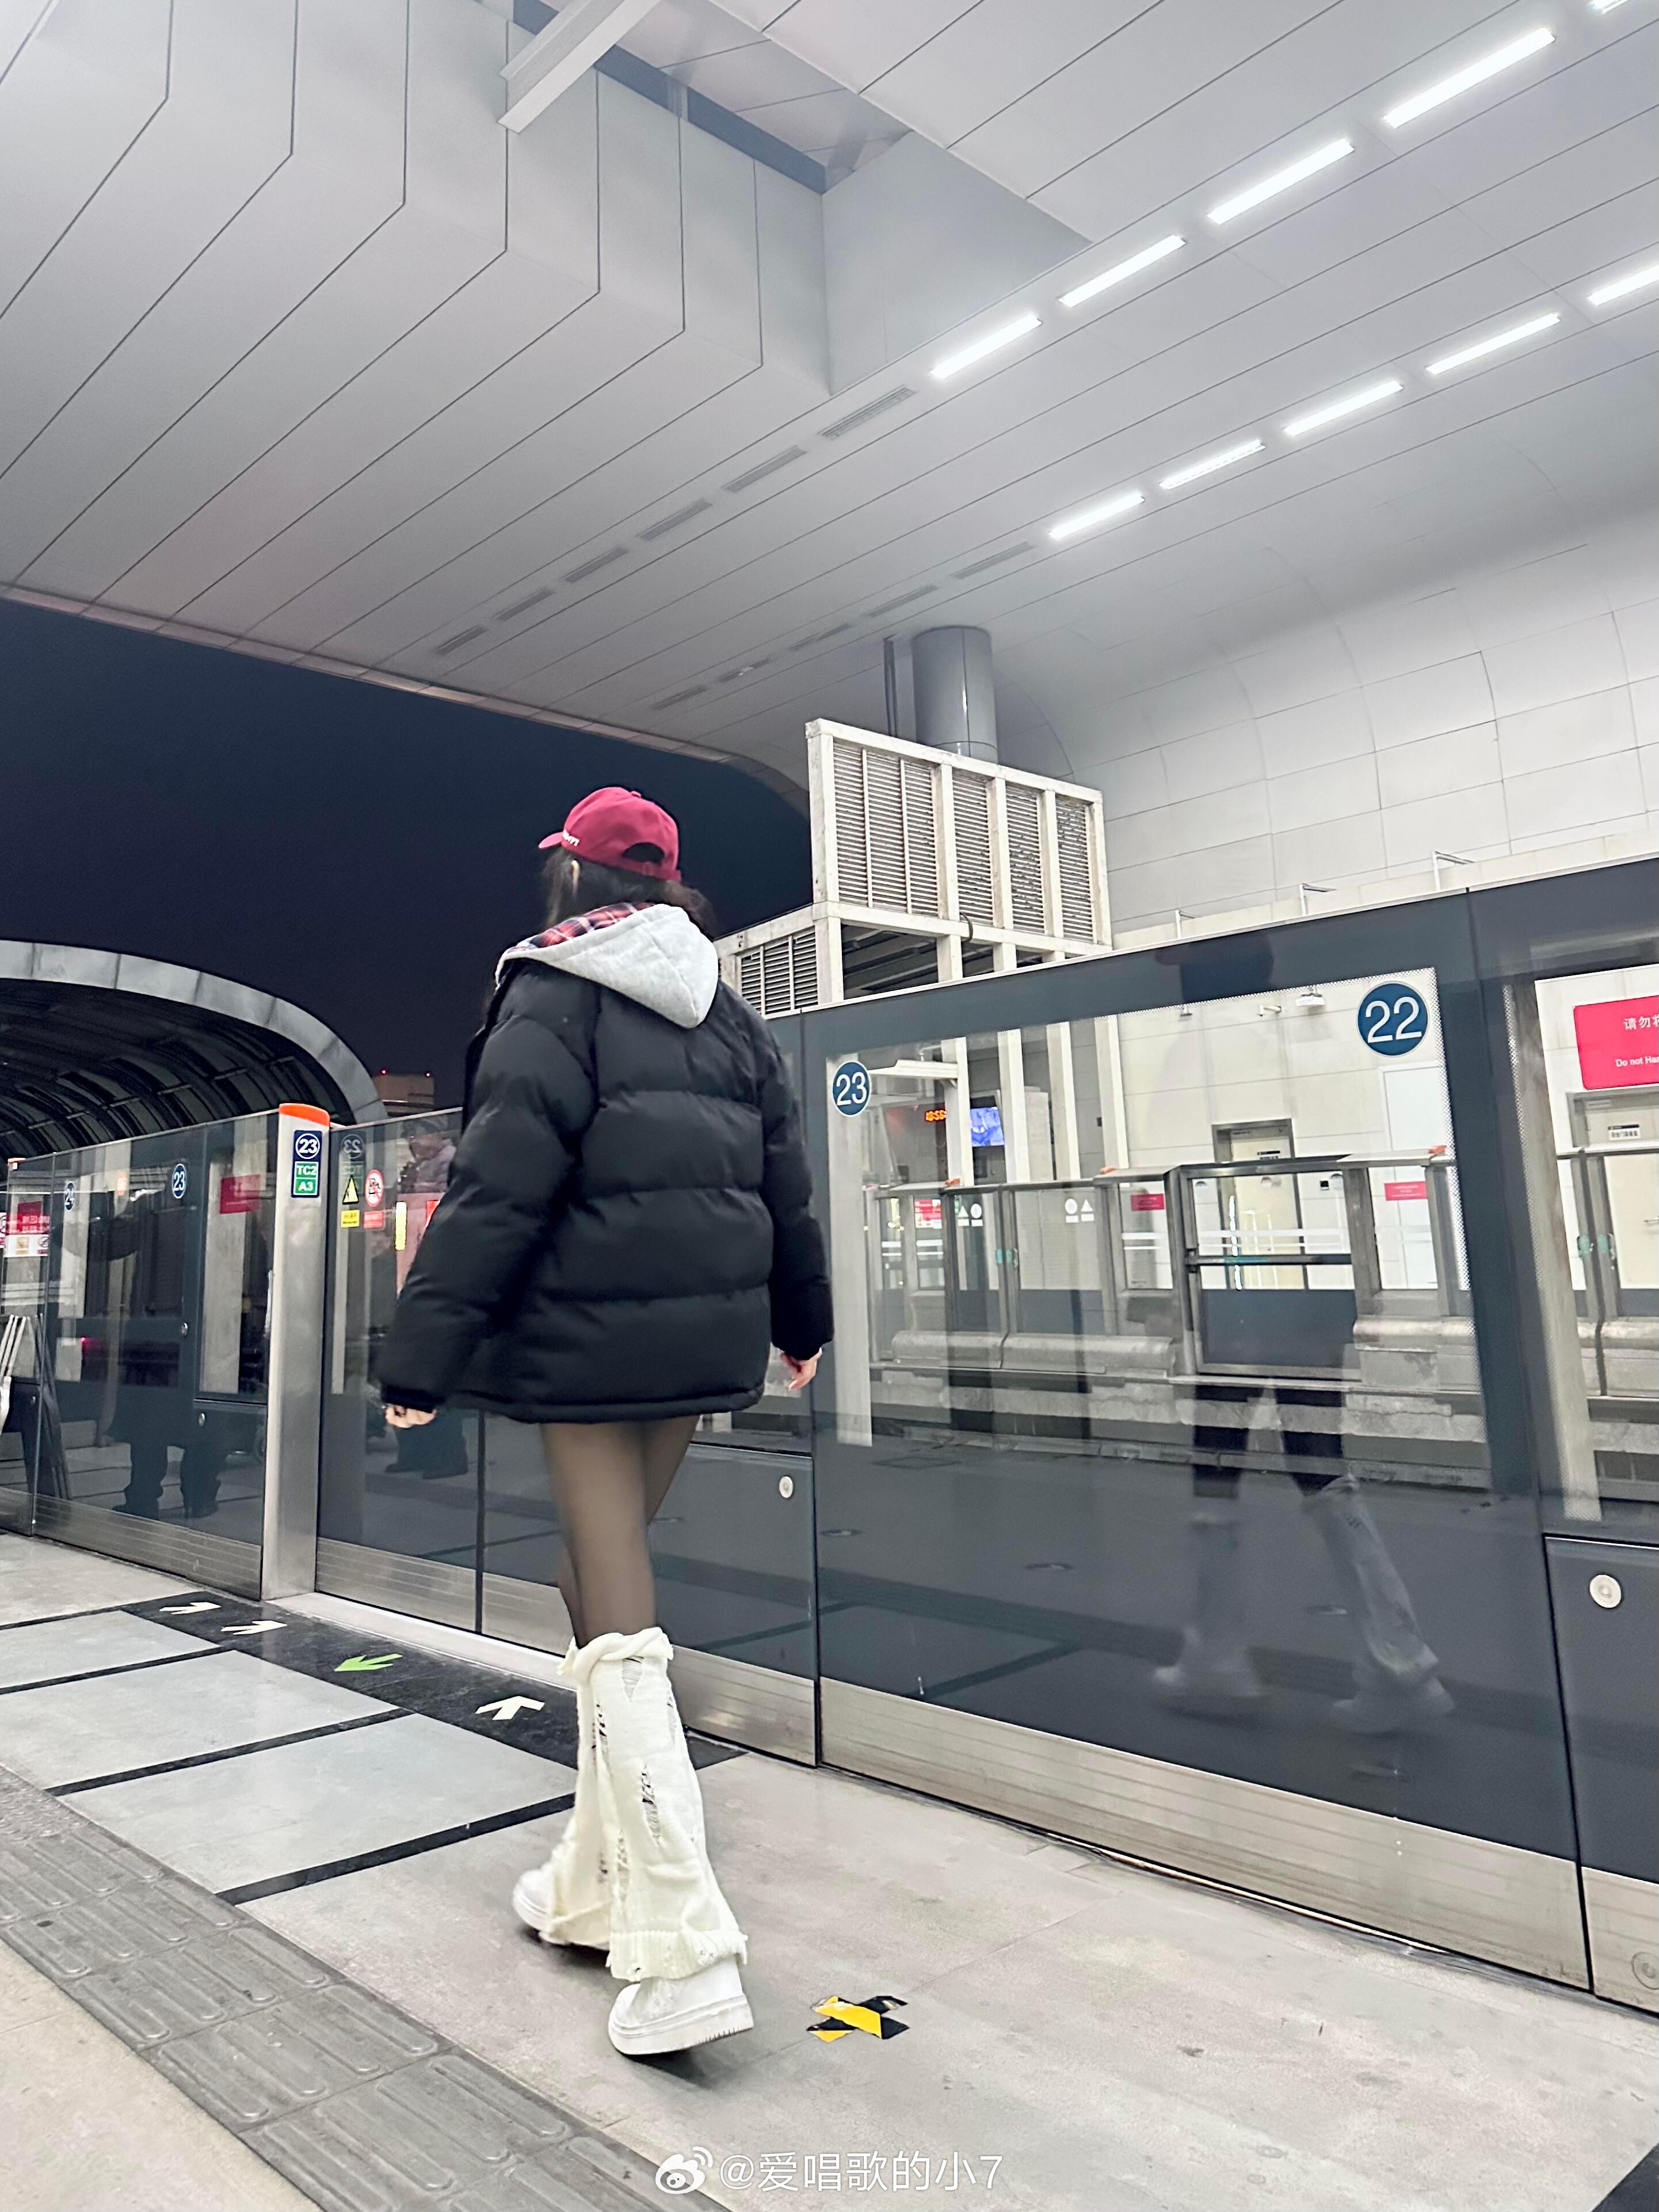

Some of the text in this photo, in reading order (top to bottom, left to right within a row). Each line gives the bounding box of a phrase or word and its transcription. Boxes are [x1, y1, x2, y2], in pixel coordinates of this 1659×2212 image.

[1366, 996, 1422, 1043] 22
[1616, 1059, 1627, 1067] Do
[1630, 1058, 1643, 1066] not
[836, 1071, 867, 1105] 23
[299, 1138, 318, 1154] 23
[296, 1165, 318, 1175] TC2
[173, 1170, 185, 1191] 23
[298, 1181, 314, 1192] A3
